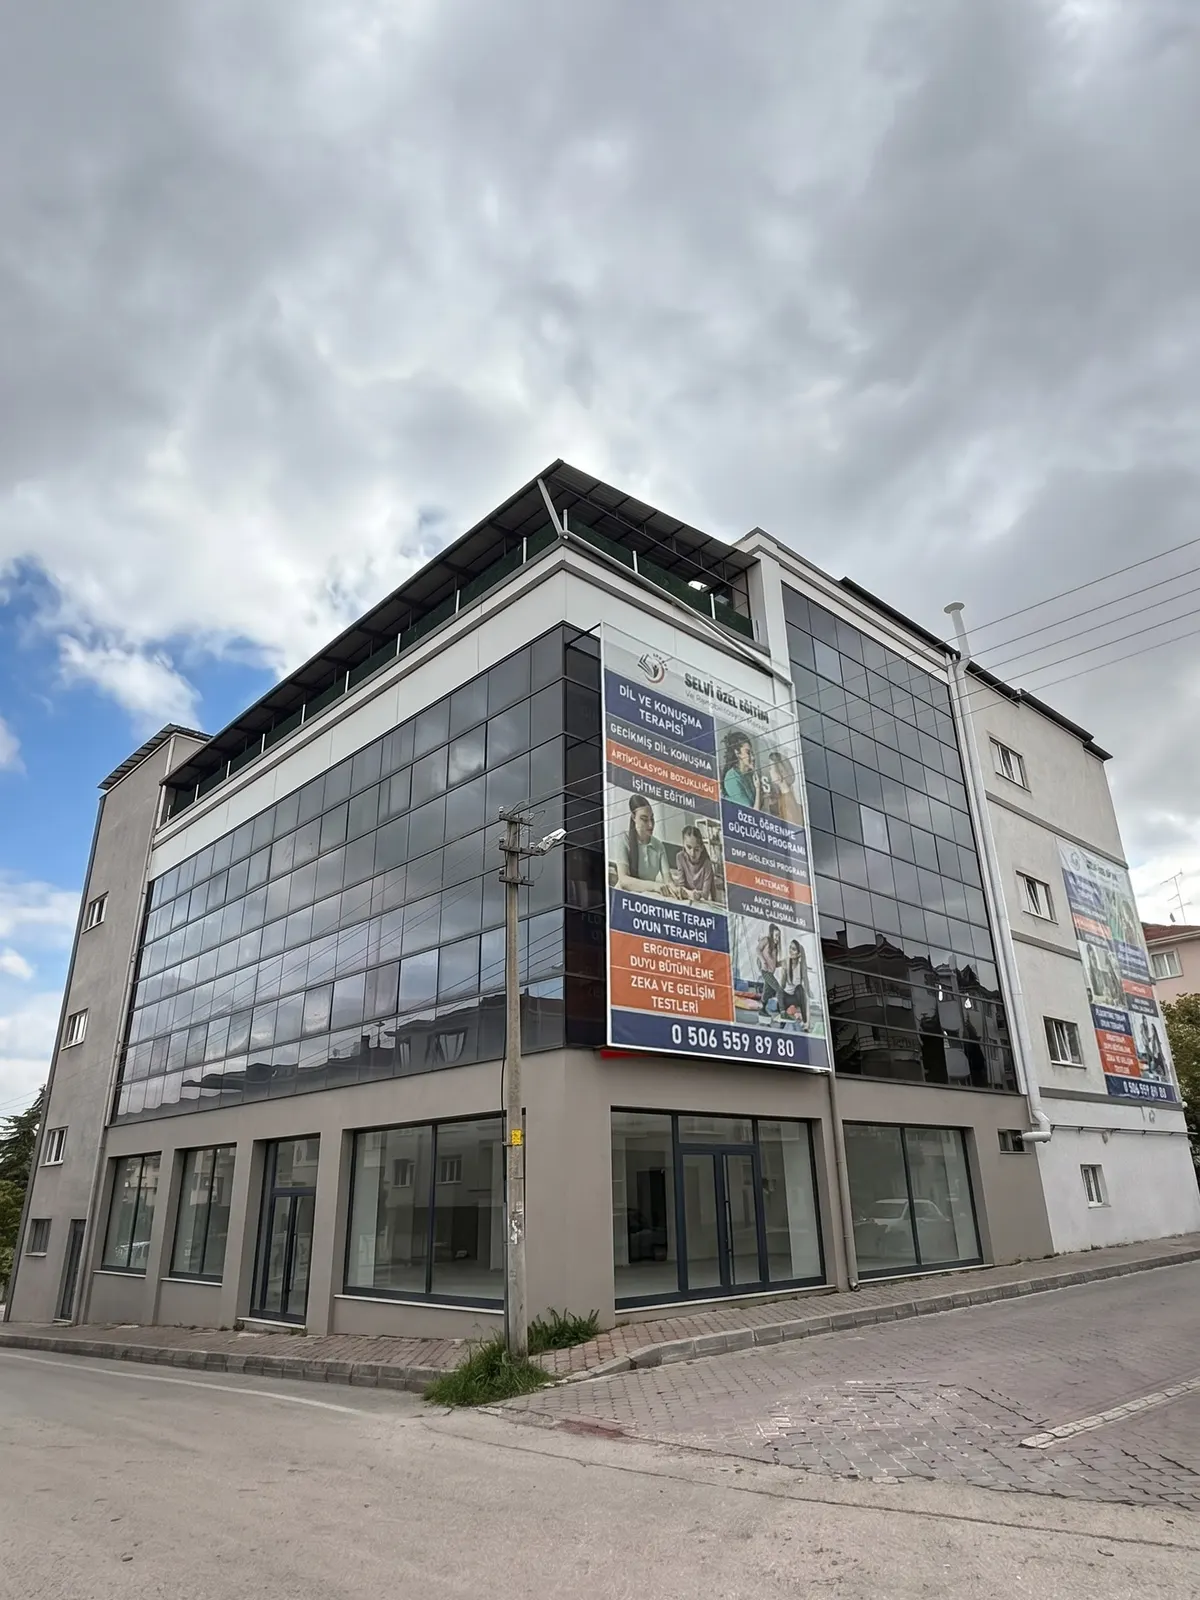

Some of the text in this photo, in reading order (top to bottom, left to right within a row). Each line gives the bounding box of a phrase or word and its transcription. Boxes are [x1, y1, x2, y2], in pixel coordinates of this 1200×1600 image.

[619, 685, 636, 701] DİL
[638, 693, 652, 708] VE
[654, 700, 703, 729] KONUŞMA
[684, 673, 714, 698] SELVİ
[716, 685, 738, 709] ÖZEL
[739, 698, 769, 724] EĞİTİM
[639, 708, 684, 736] TERAPİSİ
[610, 723, 712, 770] GECİKMİŞ DİL KONUŞMA
[611, 749, 714, 794] ARTİKÜLASYON BOZUKLUĞU
[632, 776, 696, 808] İŞİTME EĞİTİMİ
[728, 822, 766, 842] GÜÇLÜĞÜ
[737, 810, 796, 840] ÖZEL ÖĞRENME
[731, 848, 746, 858] DMP
[748, 852, 776, 868] DİSLEKSİ
[754, 876, 790, 893] MATEMATİK
[622, 898, 680, 922] FLOORTIME
[682, 911, 716, 930] TERAPİ
[741, 902, 806, 927] YAZMA ÇALIŞMALARI
[754, 895, 794, 913] AKICI OKUMA
[633, 918, 707, 944] OYUN TERAPİSİ
[643, 942, 701, 963] ERGOTERAPİ
[630, 955, 714, 981] DUYU BÜTÜNLEME
[630, 975, 716, 1000] ZEKA VE GELİŞİM
[651, 996, 699, 1014] TESTLERİ
[671, 1024, 795, 1057] 0 506 559 89 80
